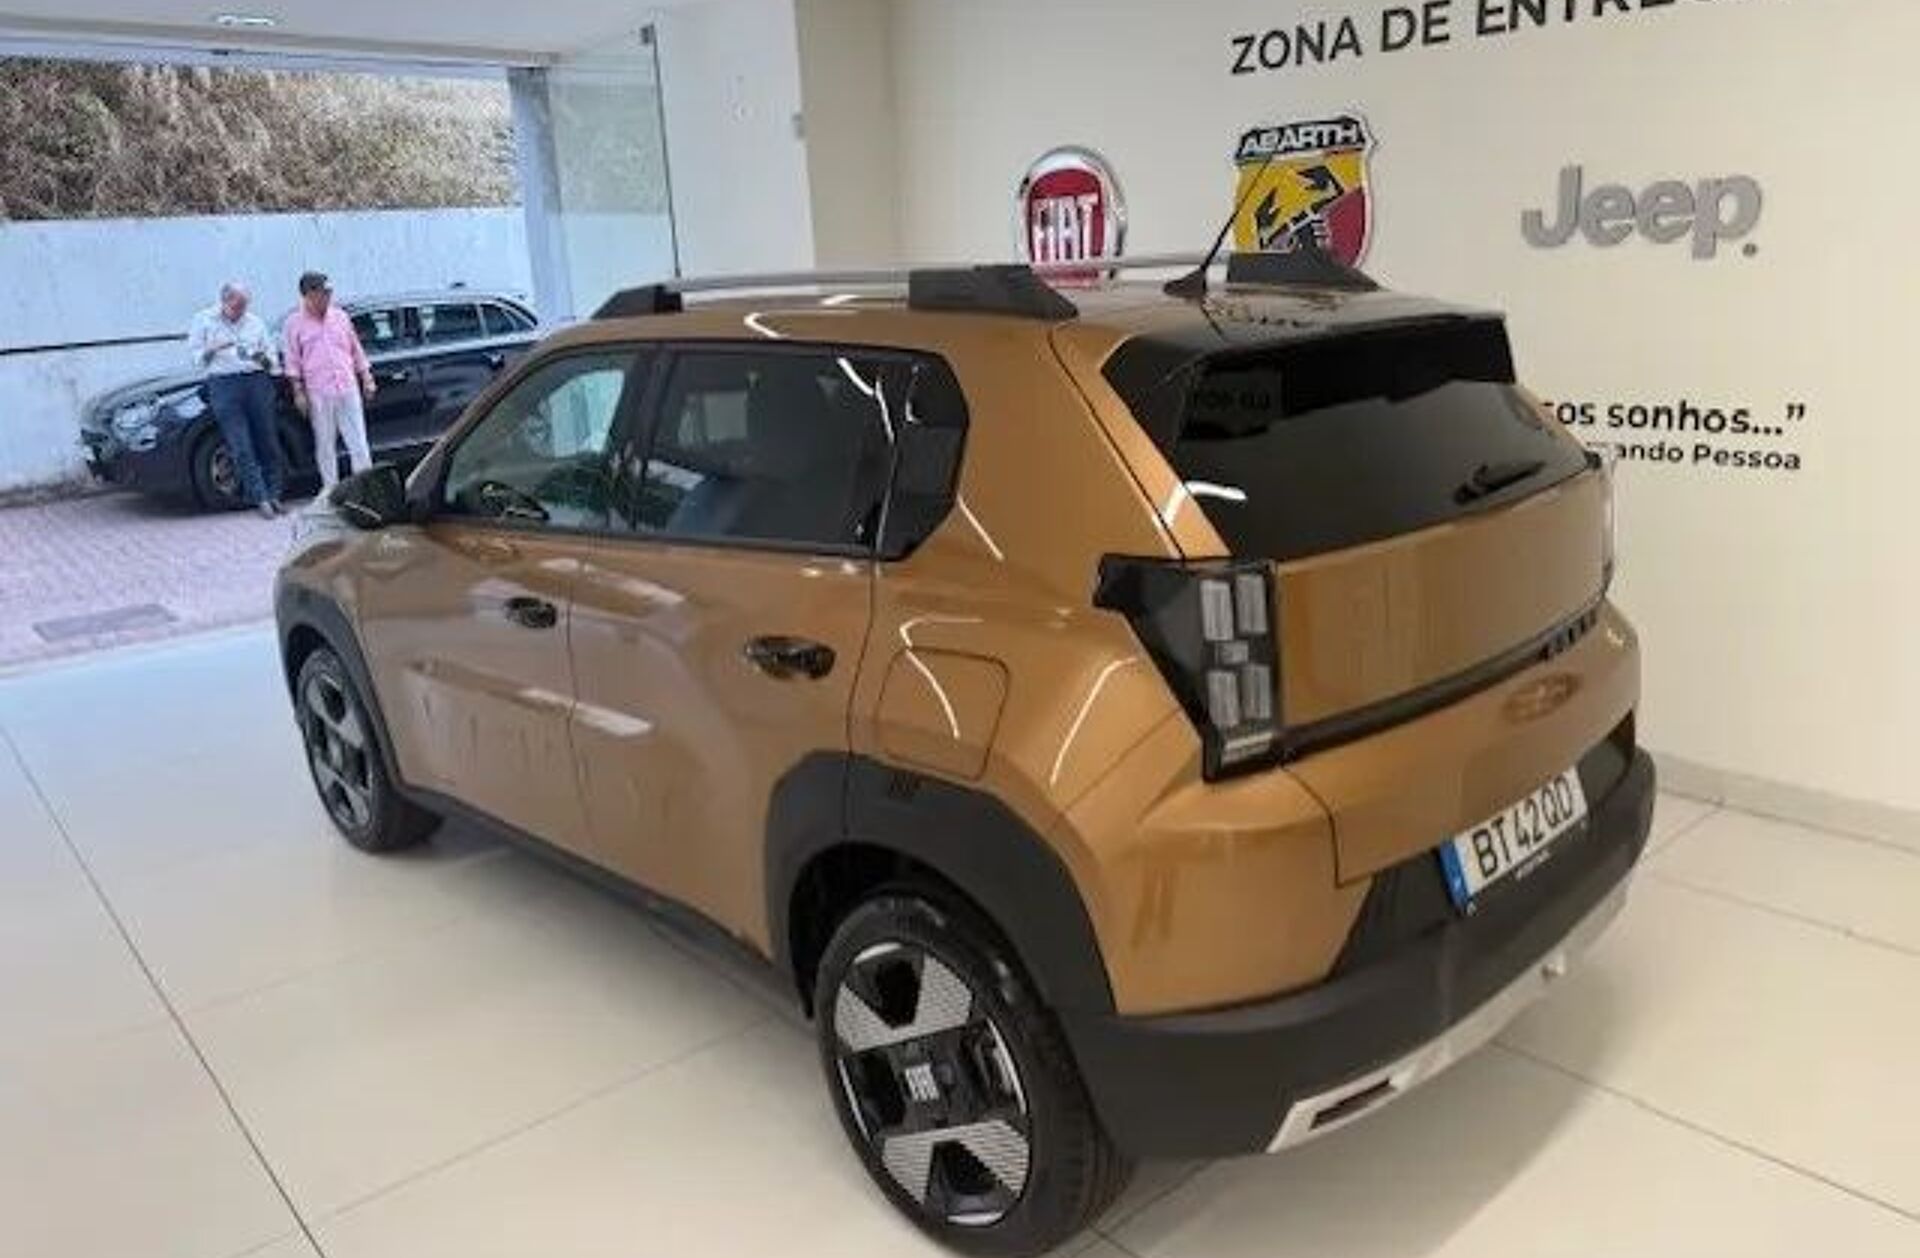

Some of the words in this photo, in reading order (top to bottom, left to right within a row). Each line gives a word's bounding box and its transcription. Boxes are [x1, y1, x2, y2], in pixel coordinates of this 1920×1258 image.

[1231, 16, 1363, 74] ZONA
[1379, 0, 1451, 52] DE
[1241, 122, 1359, 156] ABARTH
[1033, 192, 1099, 262] FIAT
[1521, 164, 1762, 259] Jeep
[1543, 401, 1596, 425] os
[1693, 444, 1801, 470] Pessoa
